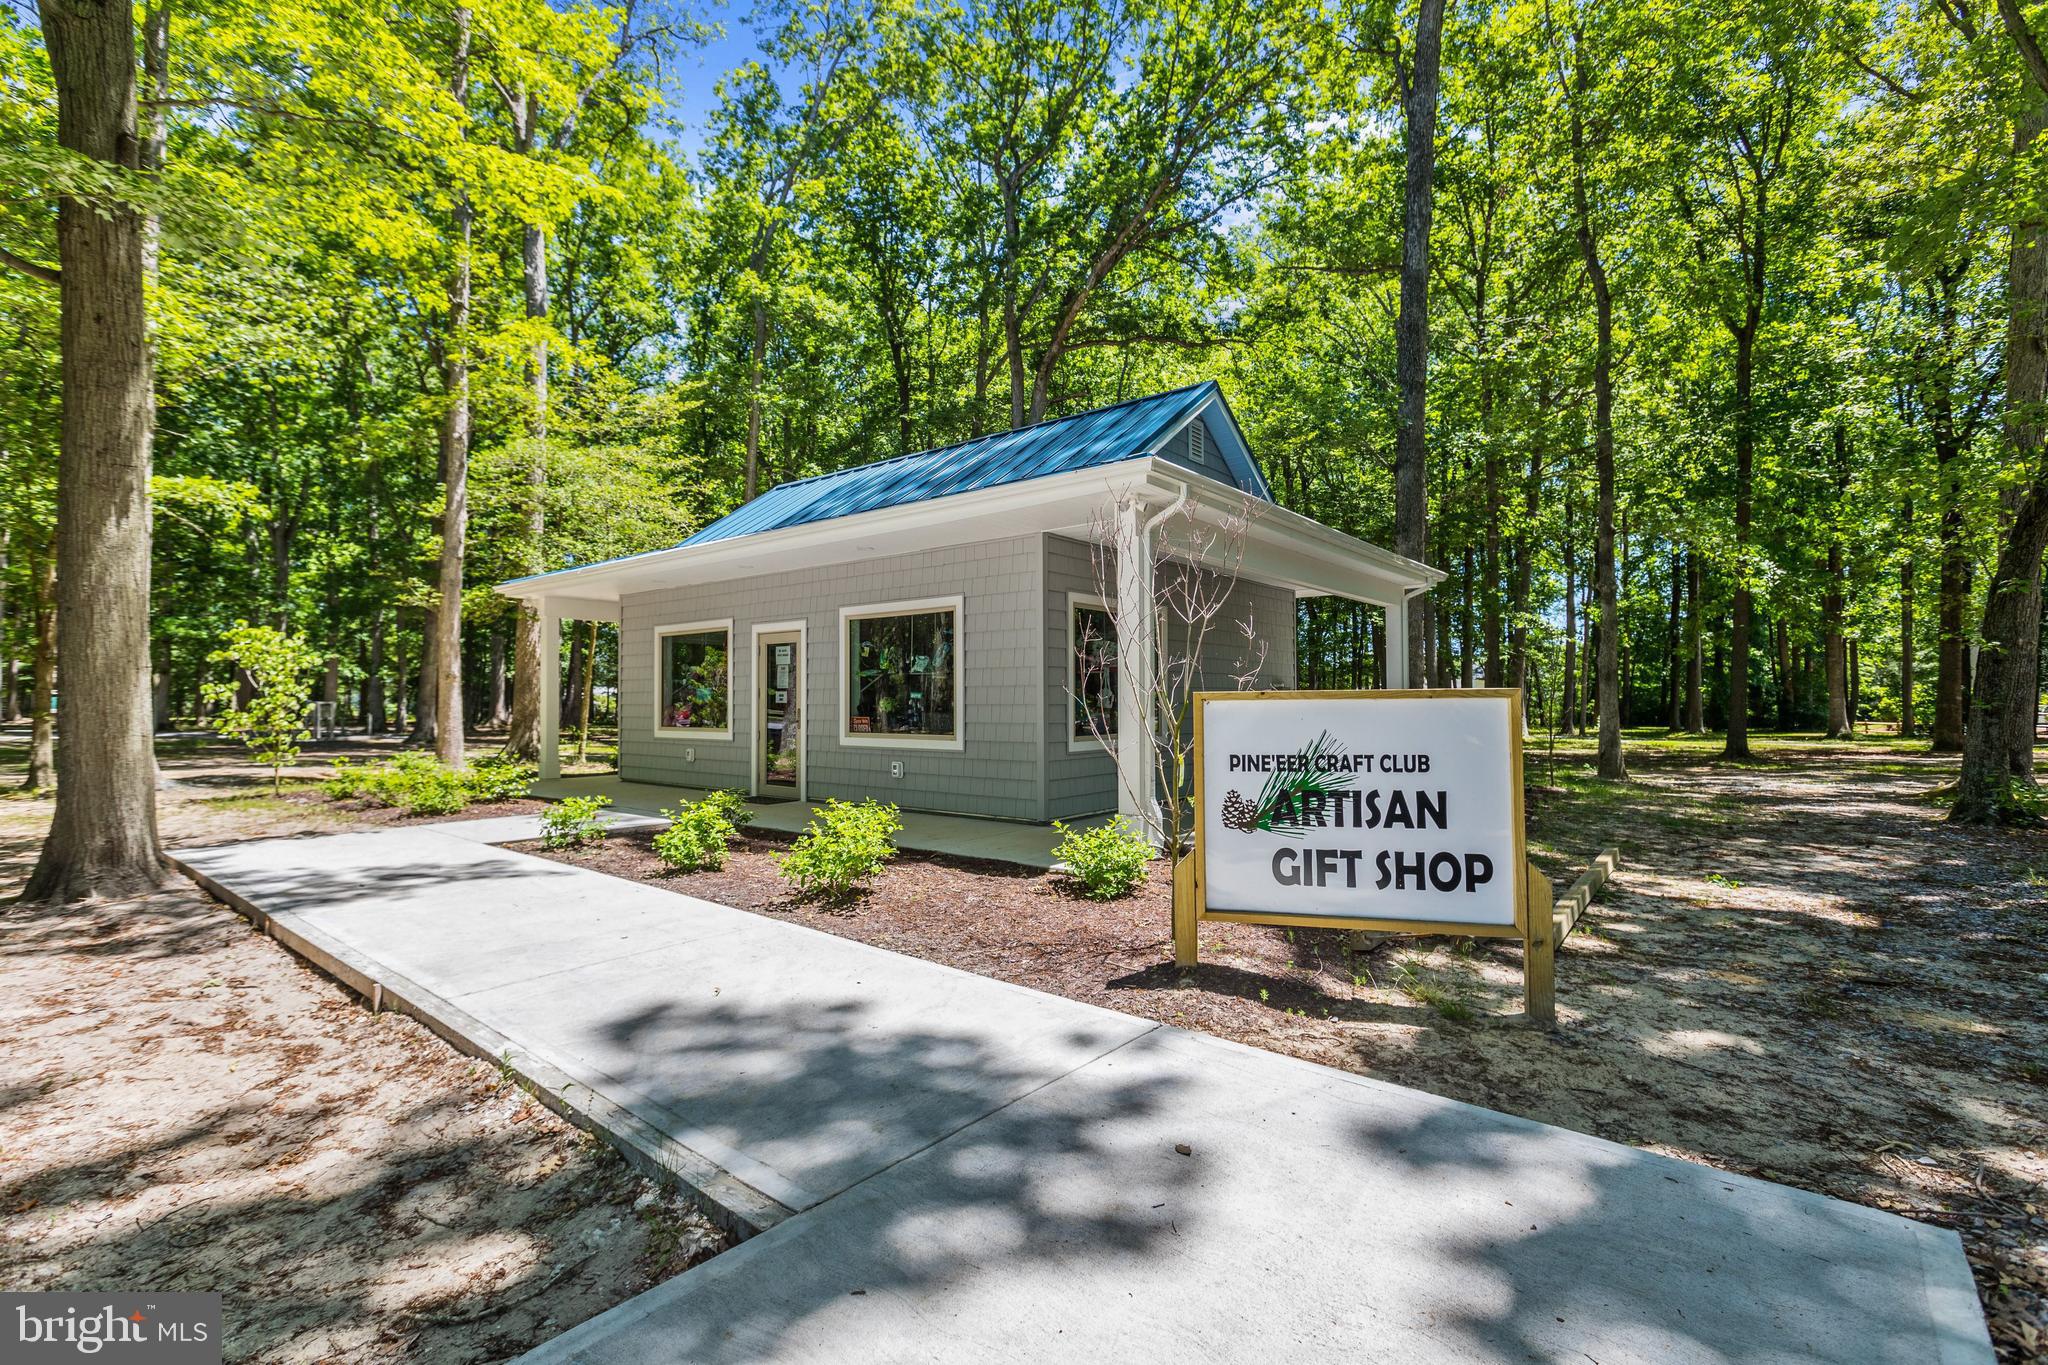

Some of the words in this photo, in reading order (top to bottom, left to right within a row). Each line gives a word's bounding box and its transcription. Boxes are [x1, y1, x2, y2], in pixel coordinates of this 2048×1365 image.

[1229, 753, 1309, 772] PINE'EER
[1315, 754, 1374, 773] CRAFT
[1379, 754, 1430, 773] CLUB
[1271, 789, 1447, 829] ARTISAN
[1272, 847, 1362, 888] GIFT
[1376, 850, 1493, 892] SHOP
